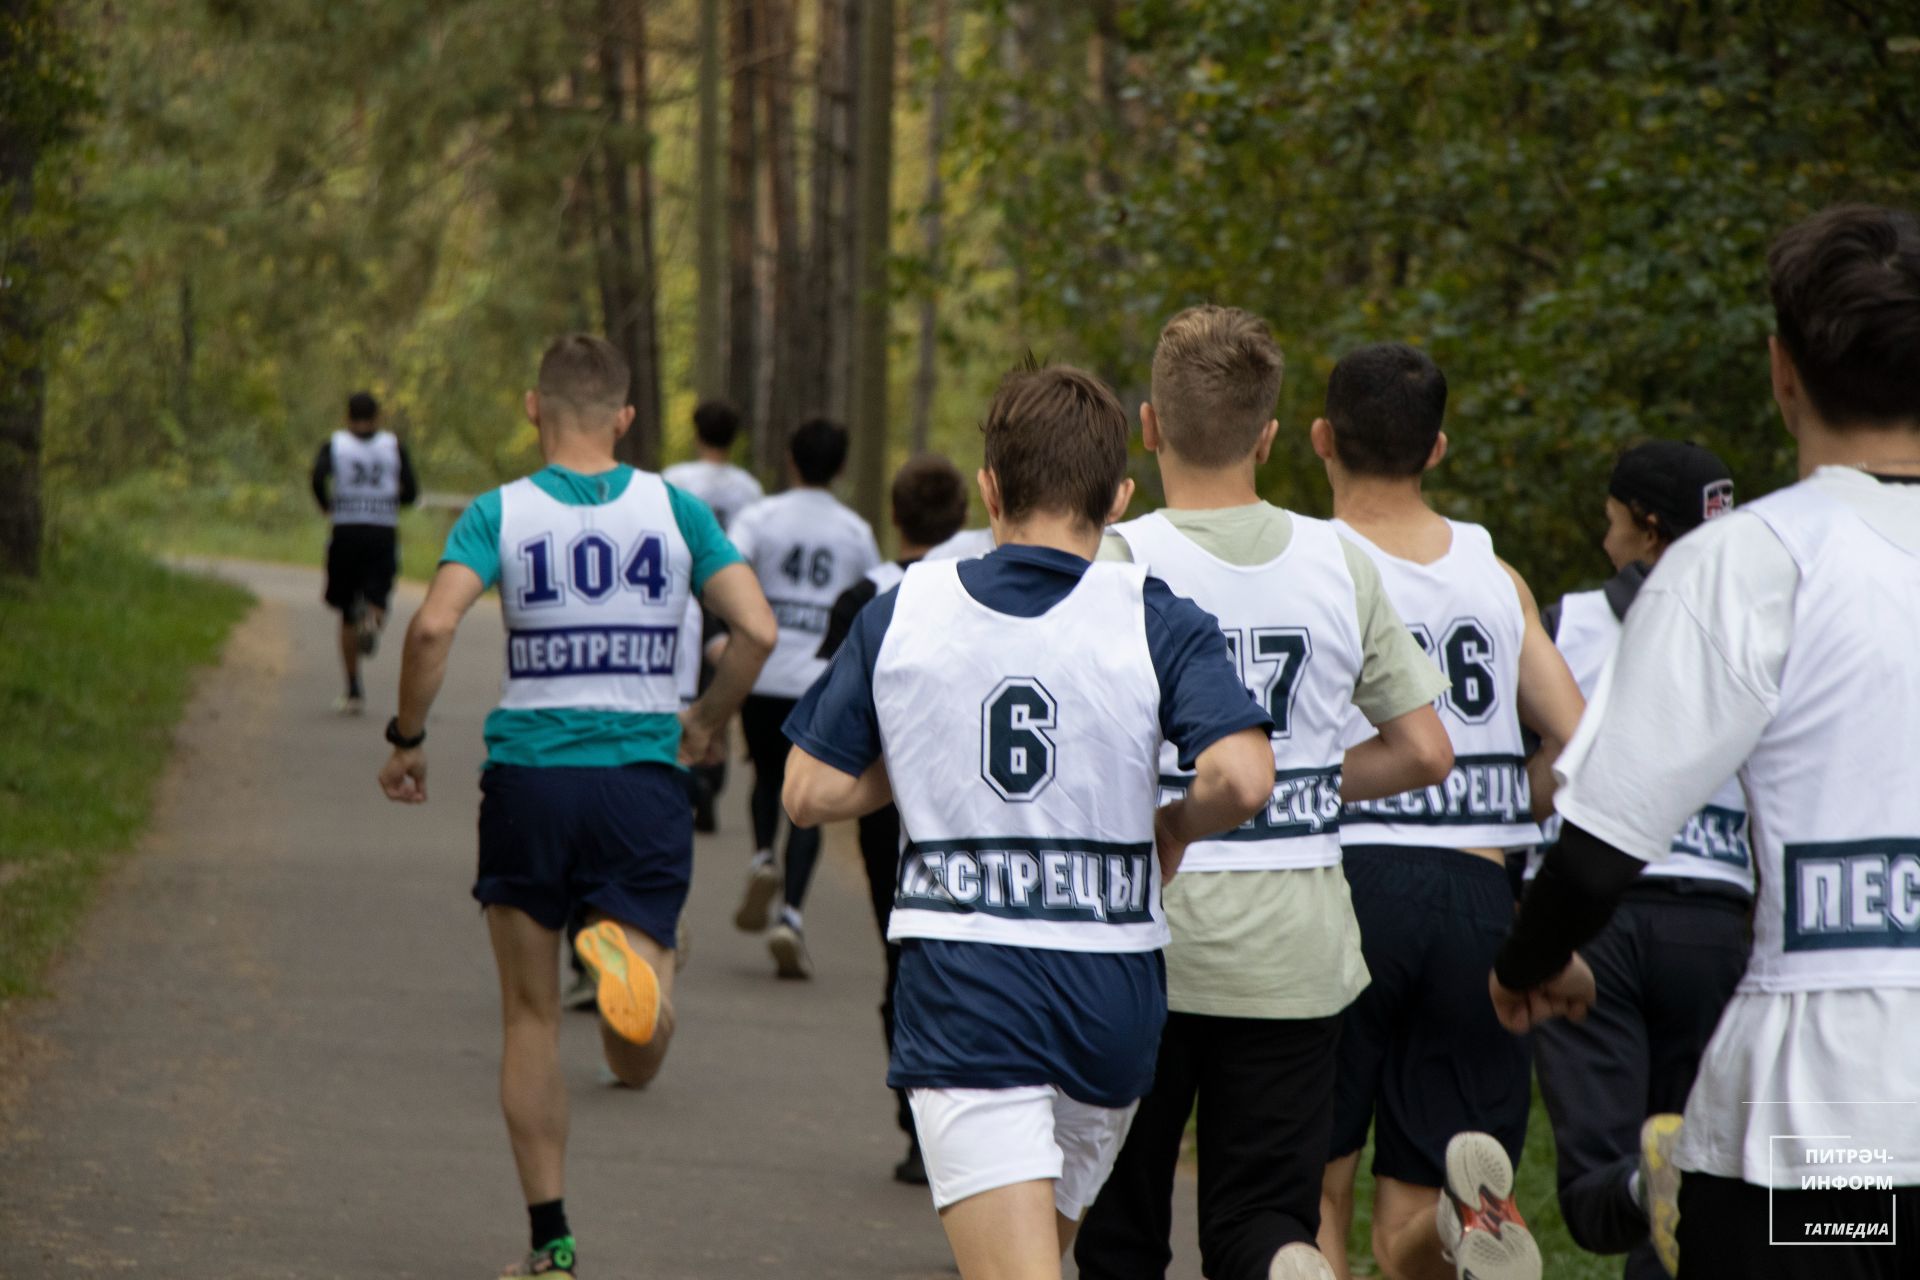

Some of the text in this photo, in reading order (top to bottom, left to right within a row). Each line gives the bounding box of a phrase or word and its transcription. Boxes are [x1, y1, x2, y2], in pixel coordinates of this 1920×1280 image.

[518, 529, 672, 611] 104
[780, 544, 836, 588] 46
[510, 630, 676, 673] ПЕСТРЕЦЫ
[1222, 626, 1313, 739] 7
[1407, 617, 1498, 725] 6
[981, 676, 1057, 802] 6
[1797, 854, 1920, 933] ПЕС
